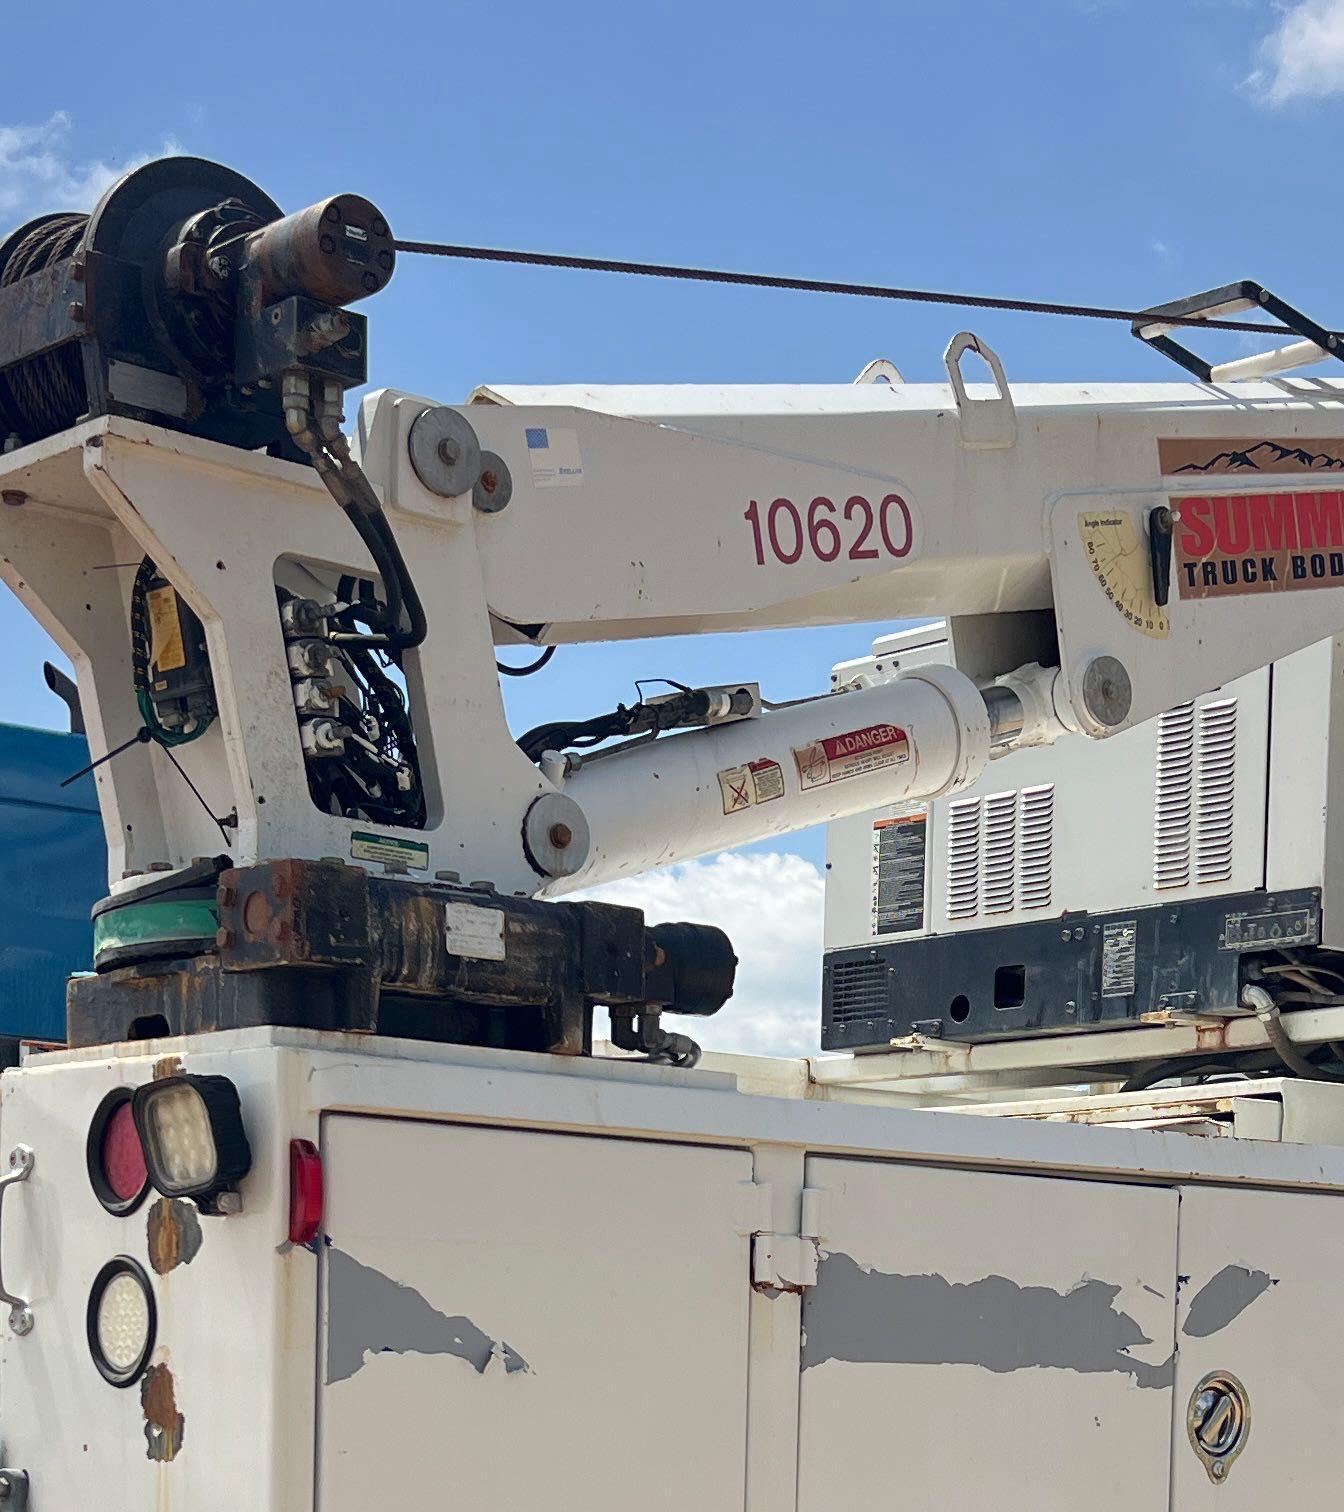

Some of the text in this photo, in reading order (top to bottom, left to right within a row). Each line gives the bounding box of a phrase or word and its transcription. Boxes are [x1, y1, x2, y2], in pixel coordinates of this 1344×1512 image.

[743, 493, 913, 566] 10620
[1183, 556, 1278, 588] TRUCK
[1146, 620, 1154, 630] 10
[846, 726, 898, 751] DANGER
